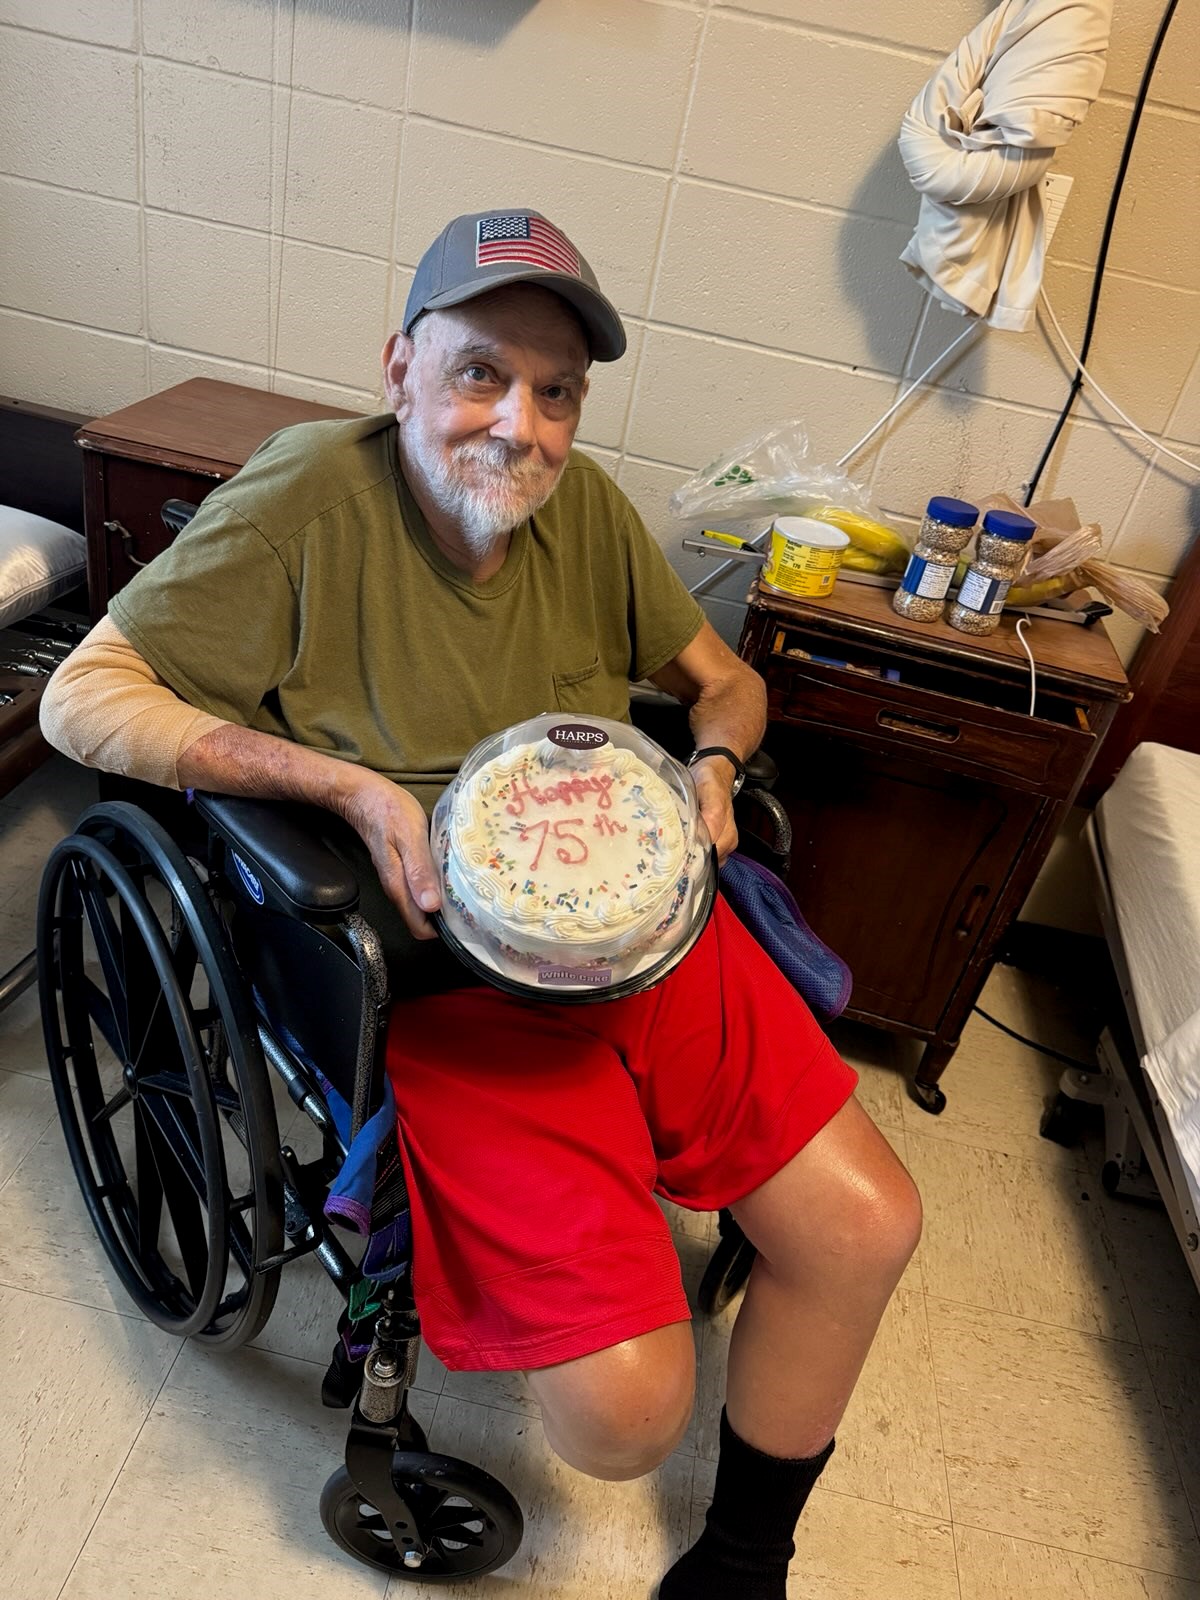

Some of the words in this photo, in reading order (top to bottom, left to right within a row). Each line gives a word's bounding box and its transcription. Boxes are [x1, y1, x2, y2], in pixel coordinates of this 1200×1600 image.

[555, 730, 604, 742] HARPS
[506, 774, 612, 816] Happy
[541, 970, 576, 980] White
[579, 974, 609, 983] Cake
